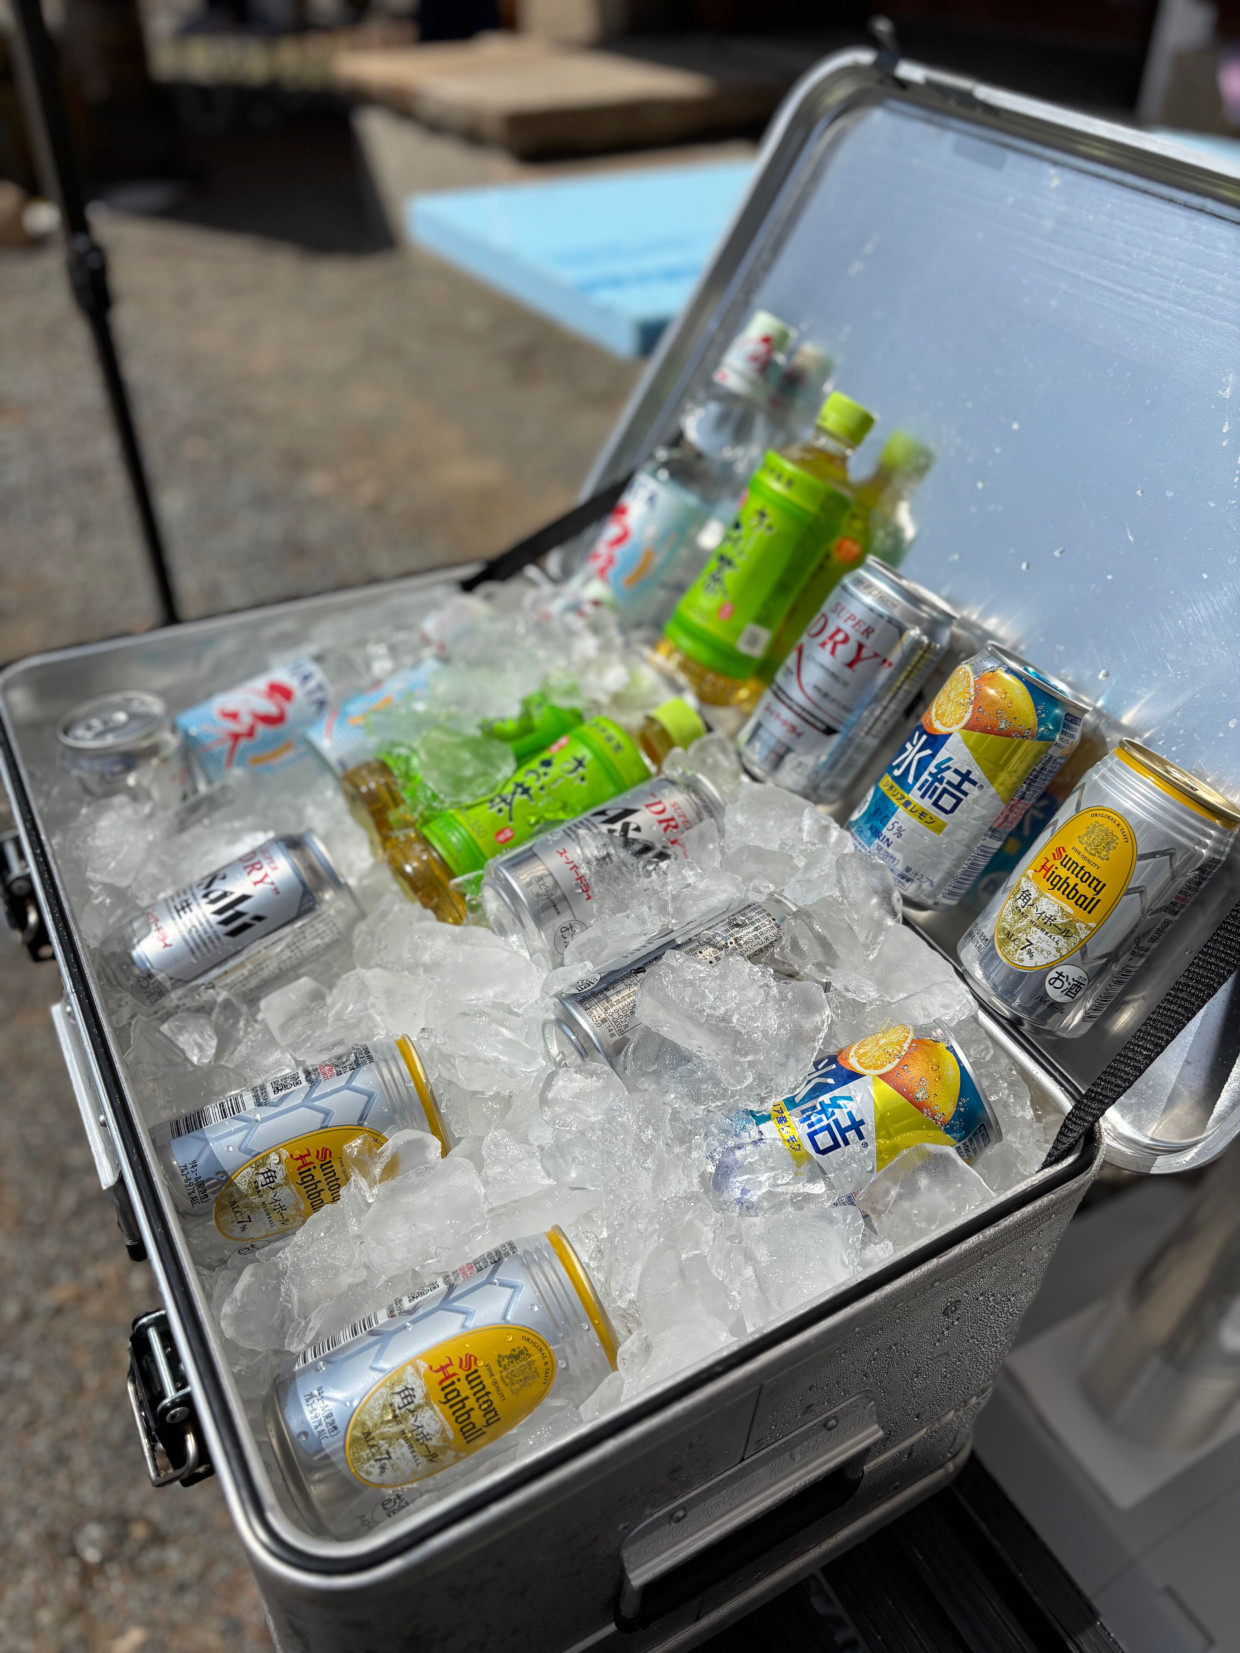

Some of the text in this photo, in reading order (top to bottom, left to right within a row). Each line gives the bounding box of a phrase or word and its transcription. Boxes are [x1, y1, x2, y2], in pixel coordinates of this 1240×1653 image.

[830, 601, 877, 640] SUPER
[892, 731, 980, 816] 氷結
[883, 781, 936, 826] シチリア産レモン
[867, 823, 893, 849] KIRIN
[886, 819, 907, 840] 5%
[1090, 812, 1115, 828] ORIGINAL
[1118, 826, 1130, 845] TASTY
[556, 848, 592, 901] スーパードライ
[1051, 846, 1107, 896] Suntory
[1080, 853, 1101, 870] QUALITY
[197, 872, 268, 939] sahi
[1033, 861, 1102, 915] Highball
[1016, 889, 1074, 939] 角ハイボール
[1018, 938, 1035, 961] 7%
[1047, 971, 1085, 999] お酒
[257, 1167, 290, 1226] 角ハイボール
[236, 1216, 253, 1232] 7%
[521, 1335, 547, 1361] ORIGINAL
[429, 1355, 488, 1445] Highball
[458, 1353, 501, 1426] Suntory
[484, 1363, 506, 1402] FINE QUALITY
[394, 1384, 440, 1466] 角ハイボール
[373, 1449, 393, 1475] 7%
[400, 1428, 423, 1468] HIGHBALL
